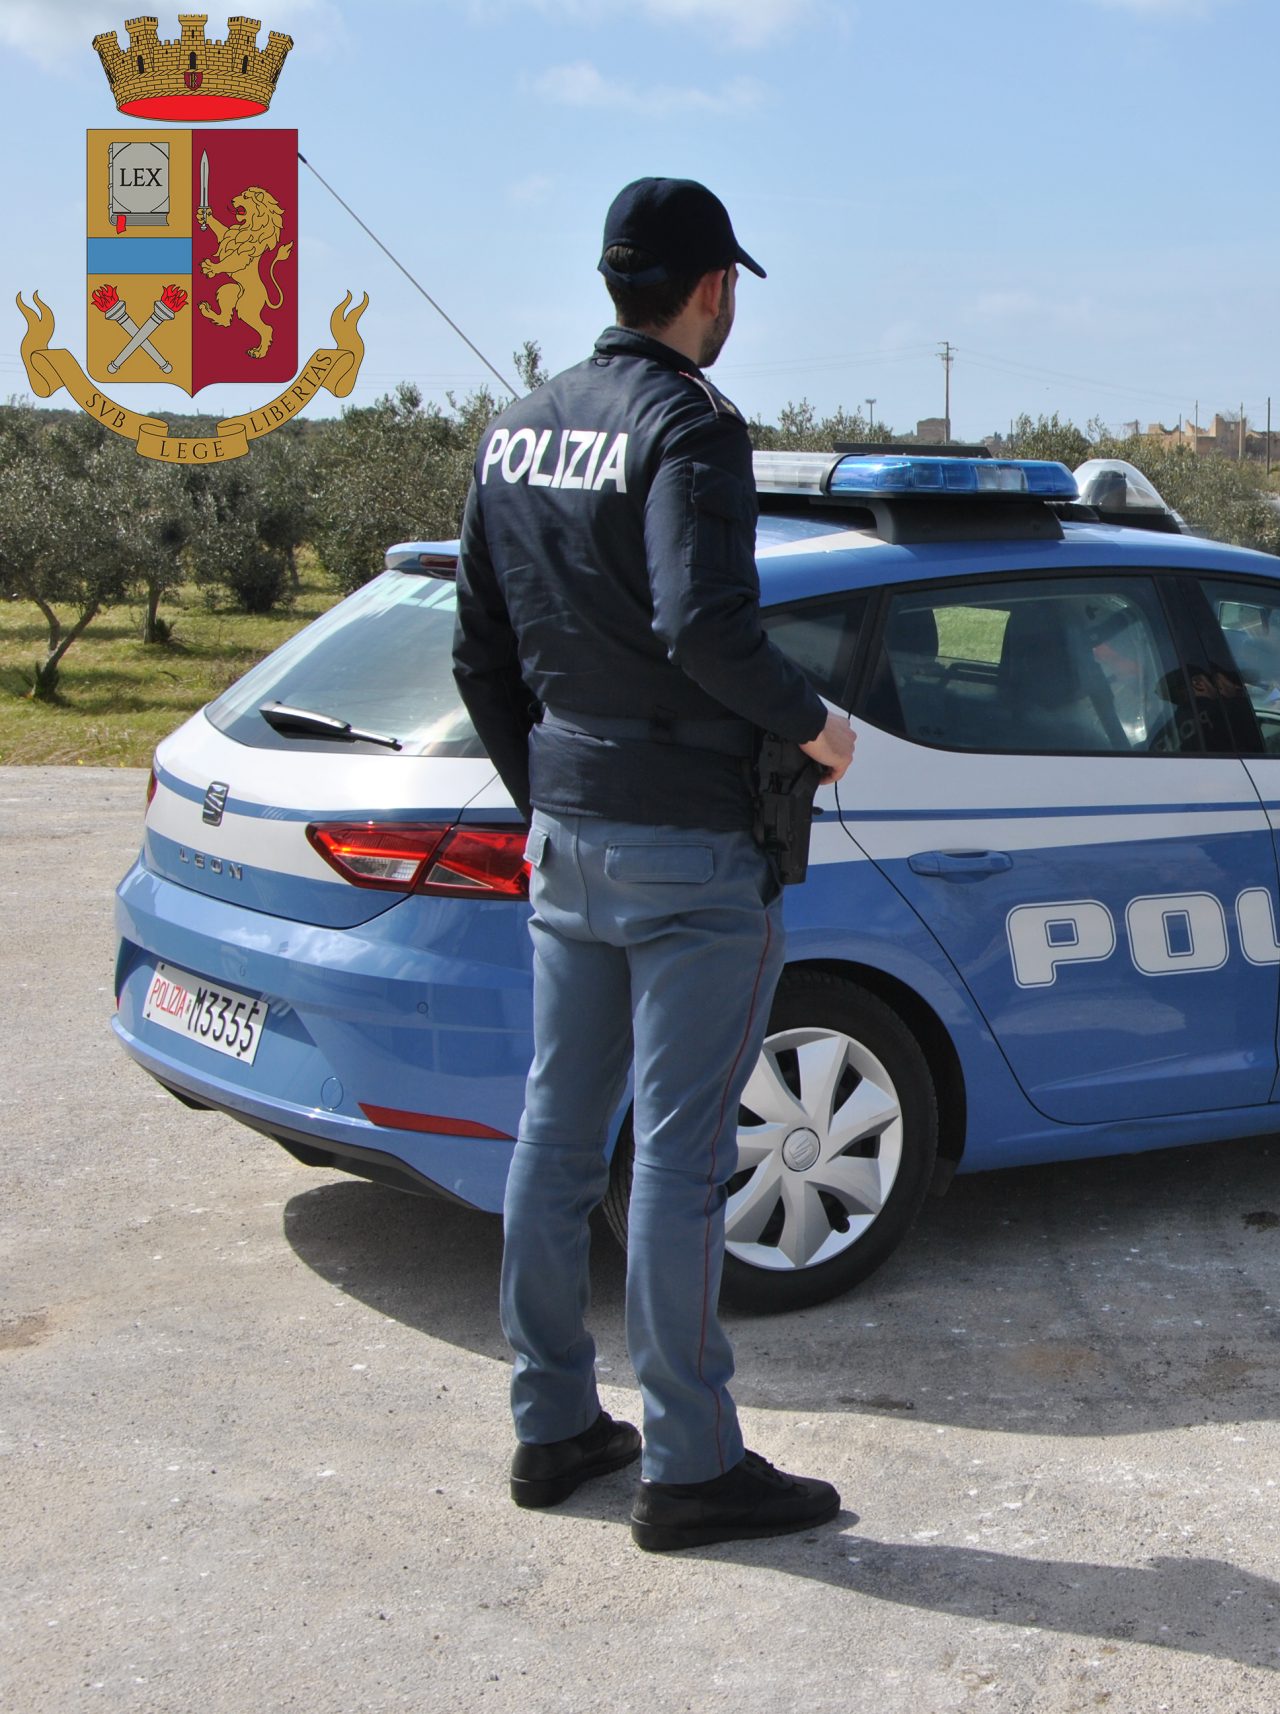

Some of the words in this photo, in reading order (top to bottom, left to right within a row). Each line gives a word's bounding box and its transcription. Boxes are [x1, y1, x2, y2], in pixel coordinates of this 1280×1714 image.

[481, 427, 629, 494] POLIZIA
[179, 847, 243, 881] LEON
[149, 977, 188, 1019] POLIZIA
[187, 986, 261, 1053] M3355
